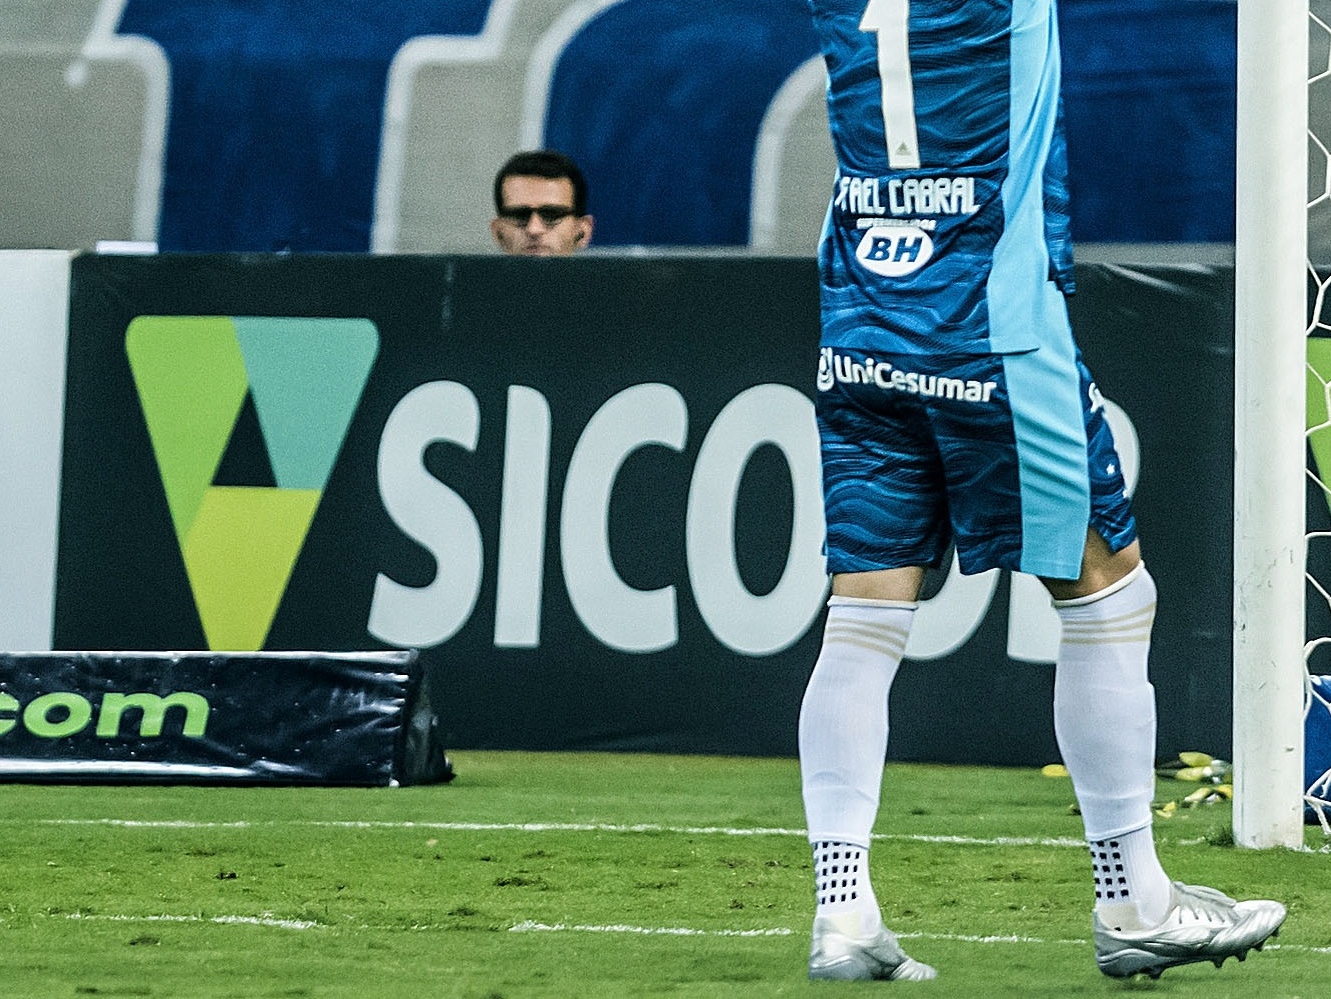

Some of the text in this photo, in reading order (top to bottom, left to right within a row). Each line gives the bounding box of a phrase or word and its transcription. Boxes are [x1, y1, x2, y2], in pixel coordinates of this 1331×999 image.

[888, 177, 981, 216] CABRAL
[863, 235, 923, 263] BH
[835, 353, 998, 403] UniCesumar
